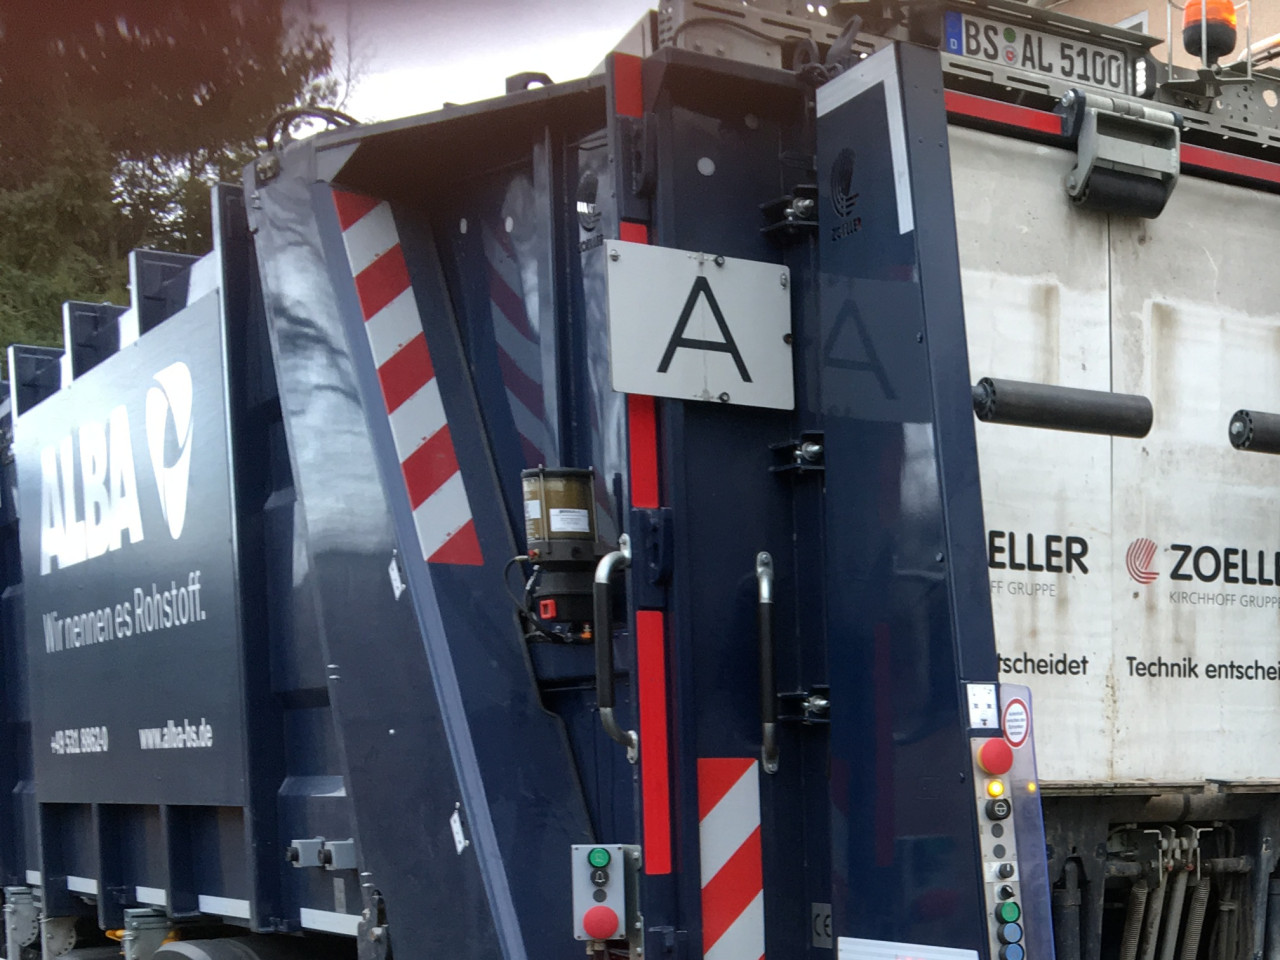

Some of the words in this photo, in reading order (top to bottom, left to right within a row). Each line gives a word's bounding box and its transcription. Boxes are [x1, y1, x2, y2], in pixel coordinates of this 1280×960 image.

[964, 18, 999, 61] BS
[1021, 33, 1053, 74] AL
[1060, 42, 1121, 88] 5100
[657, 275, 753, 383] A
[40, 404, 145, 577] ALBA
[988, 530, 1089, 575] ELLER
[42, 610, 64, 654] Wir
[64, 606, 114, 649] nennen
[114, 601, 133, 639] es
[133, 570, 207, 634] Rohstoff.
[1007, 582, 1056, 597] GRUPPE
[1169, 591, 1237, 607] KIRCHHOFF
[1126, 656, 1199, 679] Technik
